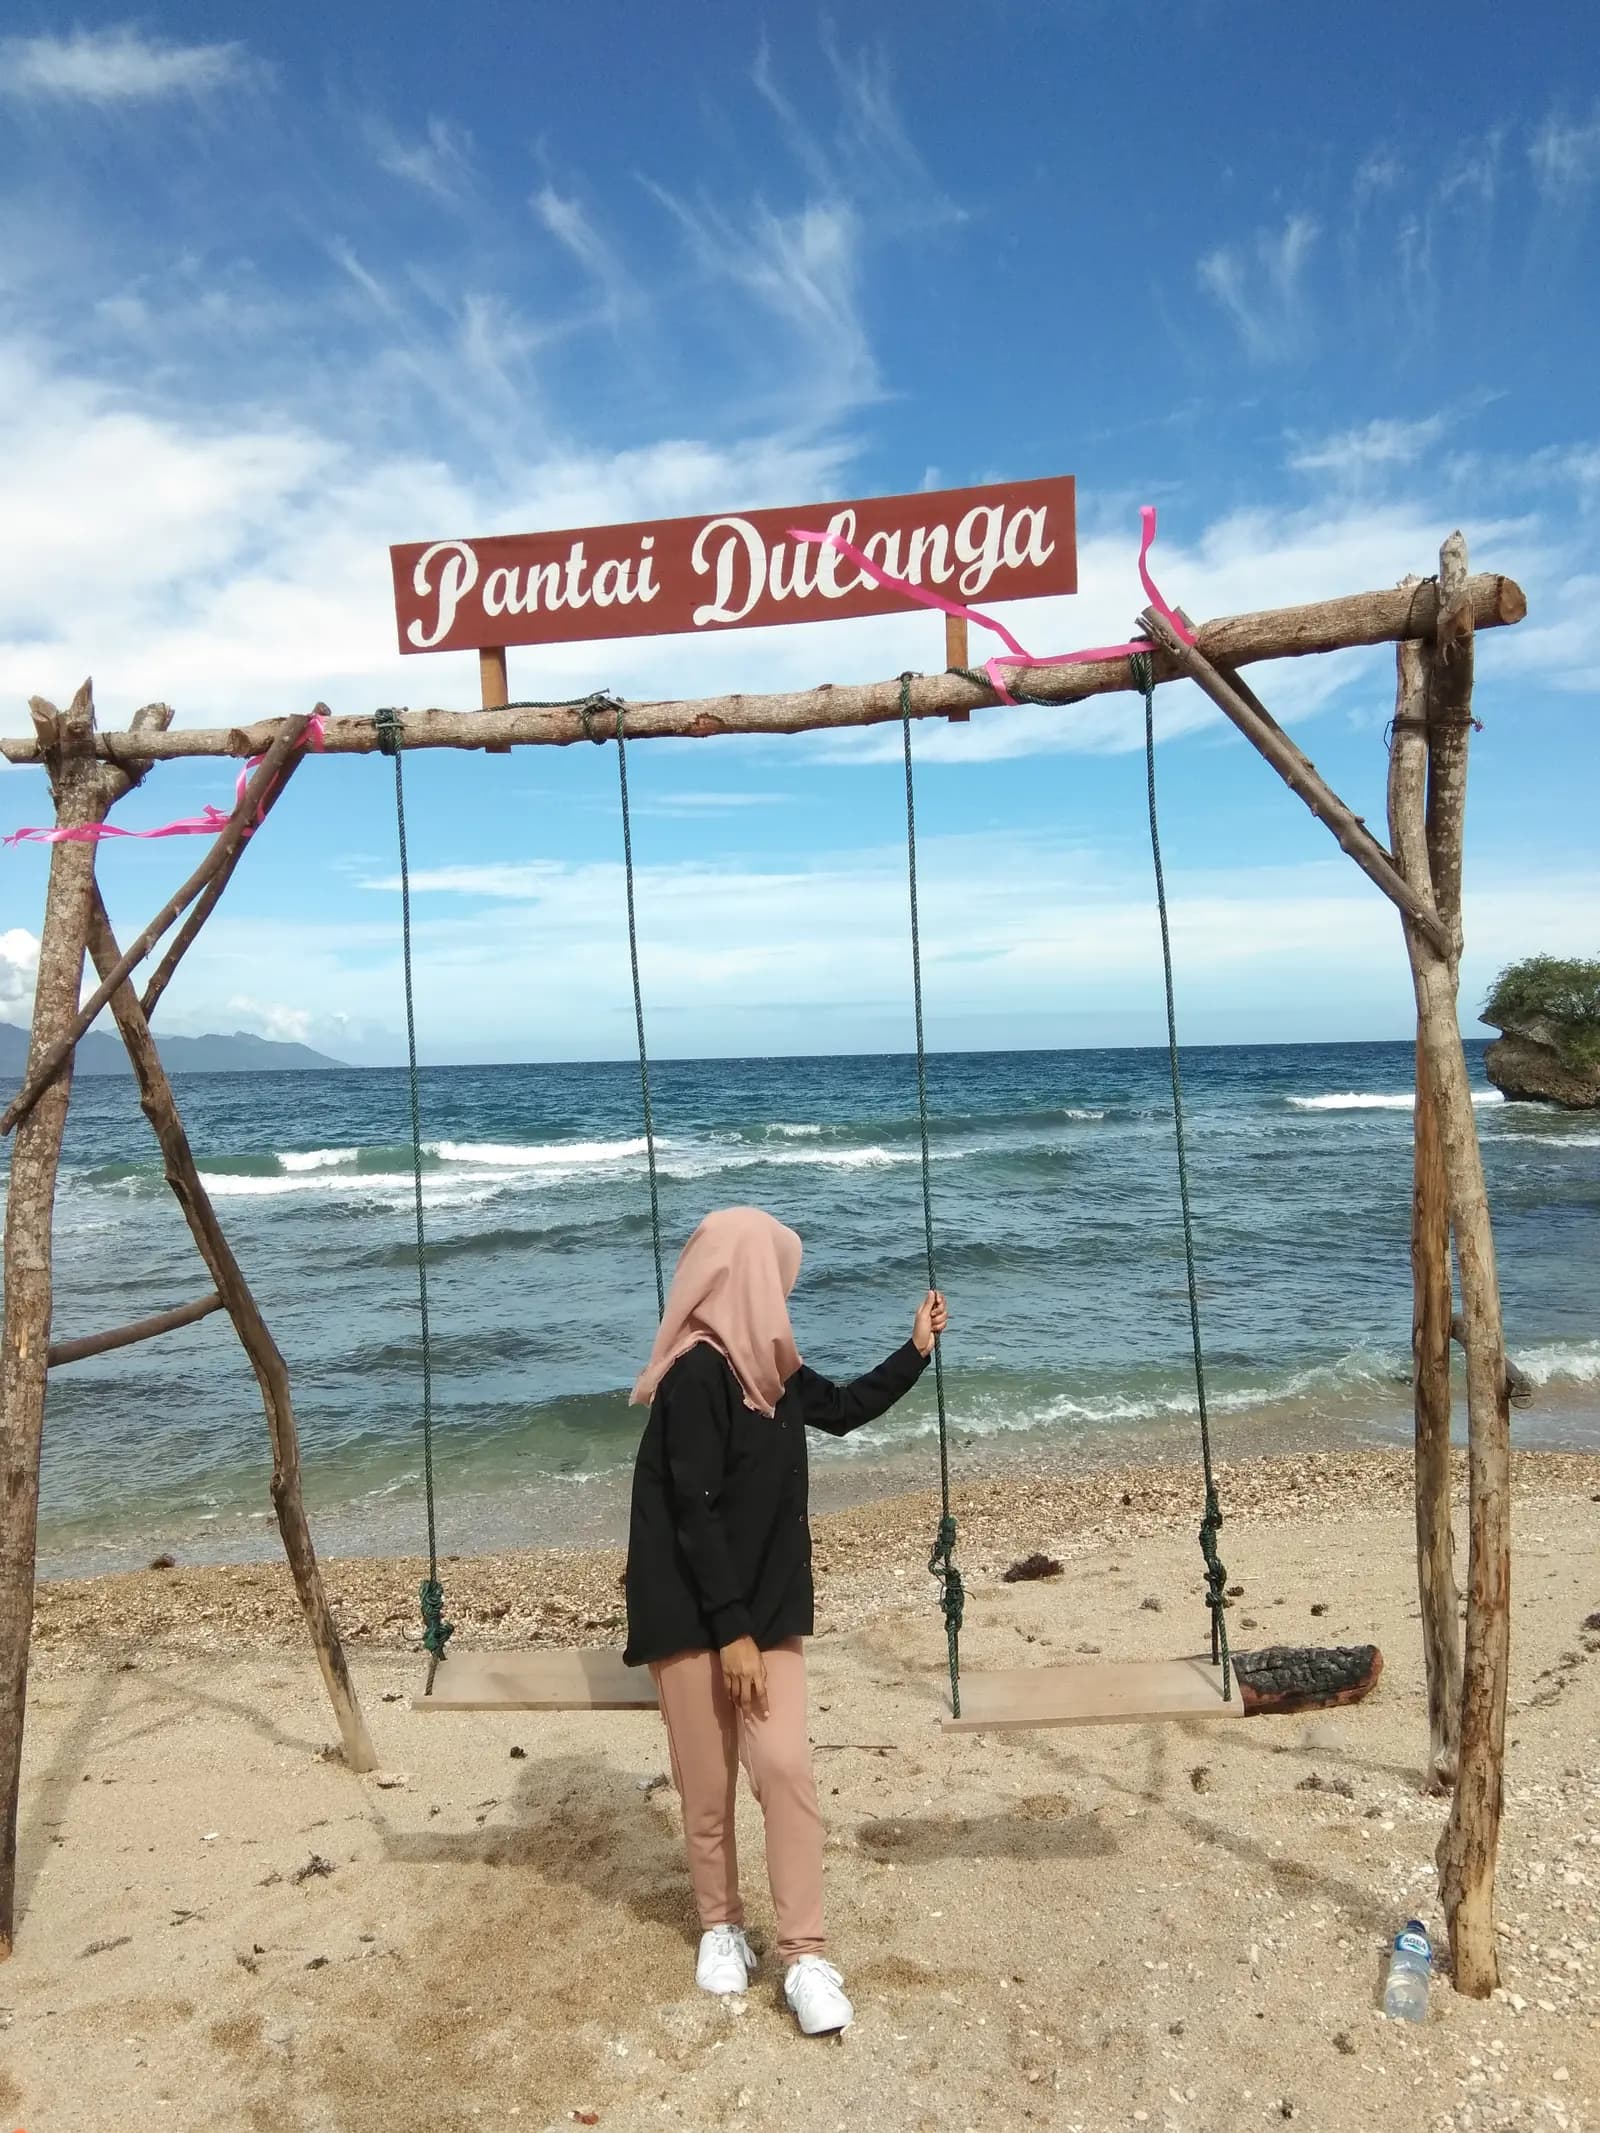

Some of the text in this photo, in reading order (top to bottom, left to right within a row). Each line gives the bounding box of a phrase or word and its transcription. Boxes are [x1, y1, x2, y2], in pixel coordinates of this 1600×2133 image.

[407, 504, 1055, 648] Pantai Dulanga
[1403, 1937, 1427, 1950] AQUA
